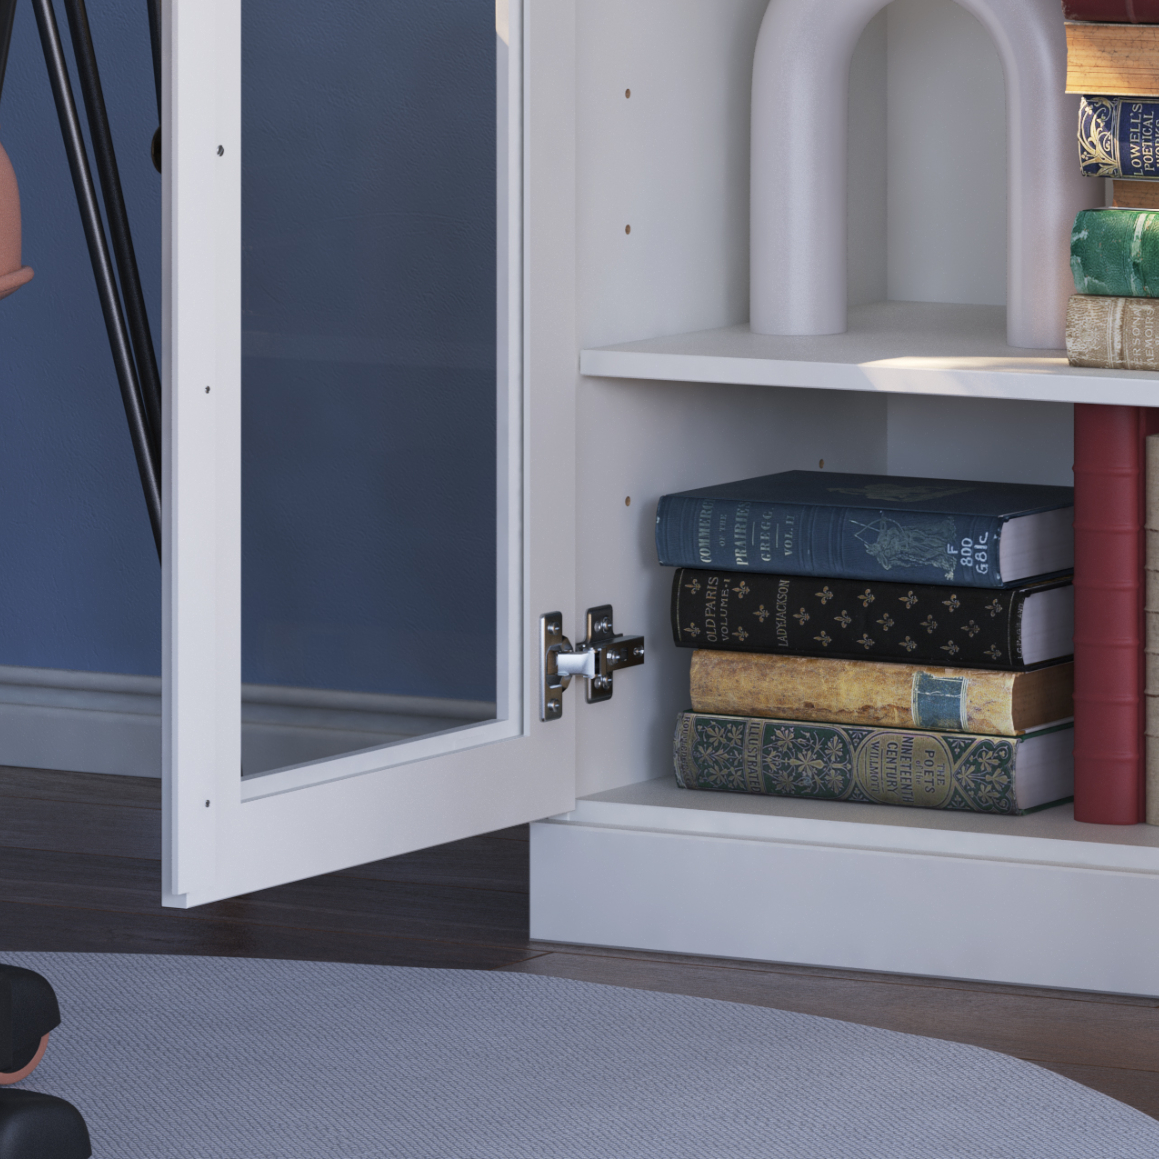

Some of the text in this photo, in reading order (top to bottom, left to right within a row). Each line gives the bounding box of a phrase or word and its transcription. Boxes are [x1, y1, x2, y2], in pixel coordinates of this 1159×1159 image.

[1129, 103, 1144, 176] LOWELL'S
[1142, 111, 1155, 172] POETICAL
[946, 543, 959, 554] F
[747, 722, 761, 793] ILLUSTRATED
[869, 741, 880, 794] WILLMOTT
[885, 742, 899, 796] CENTURY
[900, 736, 915, 803] NINETEENTH
[924, 749, 936, 794] POETS
[936, 763, 946, 786] THE
